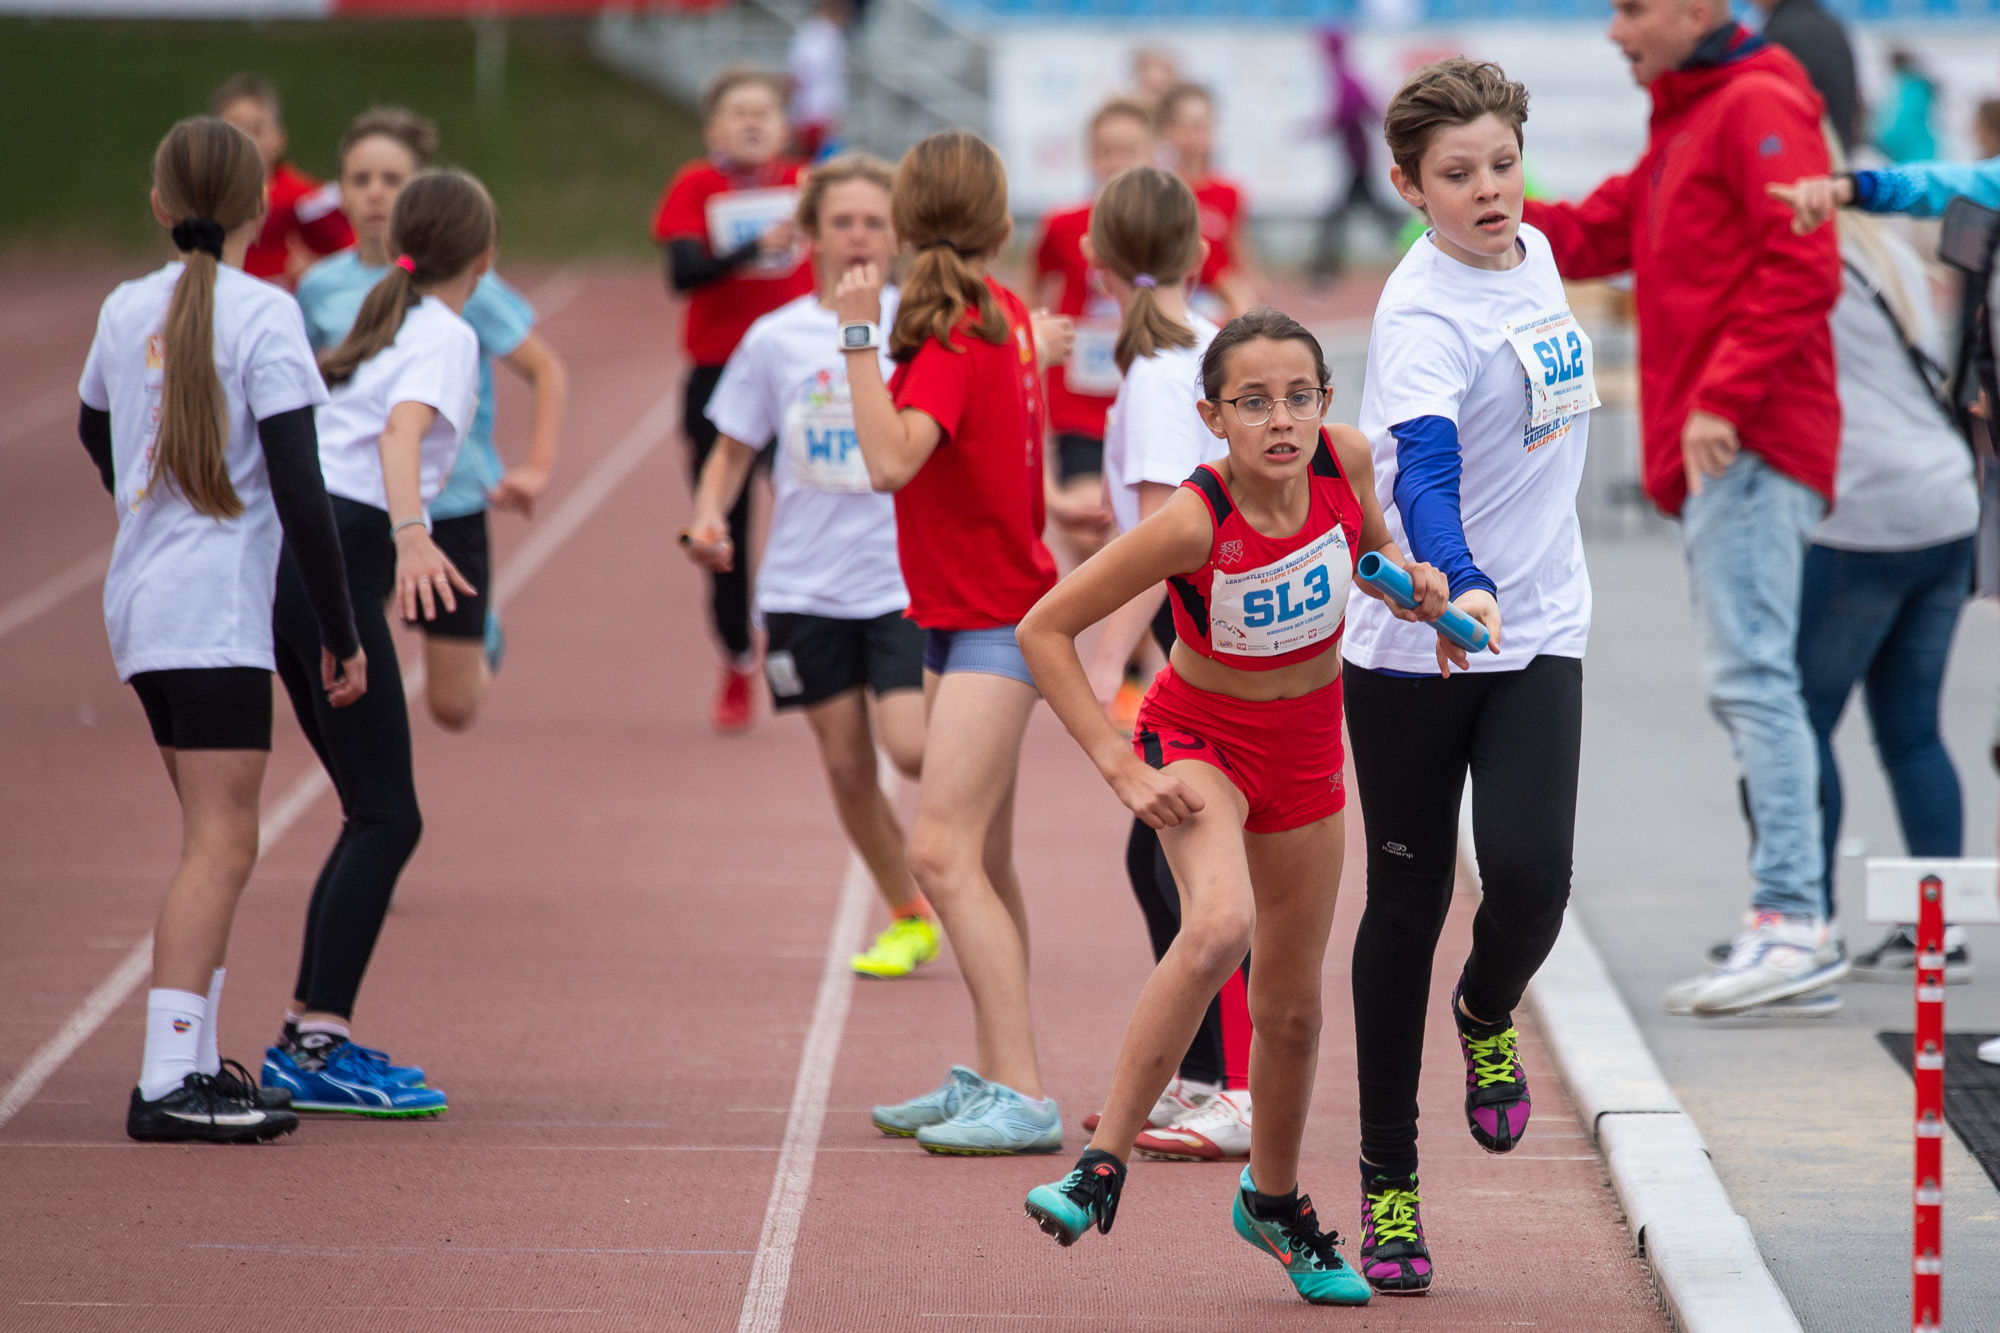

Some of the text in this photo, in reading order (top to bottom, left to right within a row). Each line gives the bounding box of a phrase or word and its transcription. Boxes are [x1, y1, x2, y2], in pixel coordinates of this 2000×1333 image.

[1533, 330, 1584, 387] SL2
[805, 427, 859, 465] WP
[1523, 418, 1560, 448] NADZIEJE
[1527, 431, 1557, 454] NAJLEPSI
[1285, 552, 1310, 569] NADZIEJE
[1310, 533, 1340, 556] OLIMPIJSKIE
[1243, 564, 1331, 628] SL3
